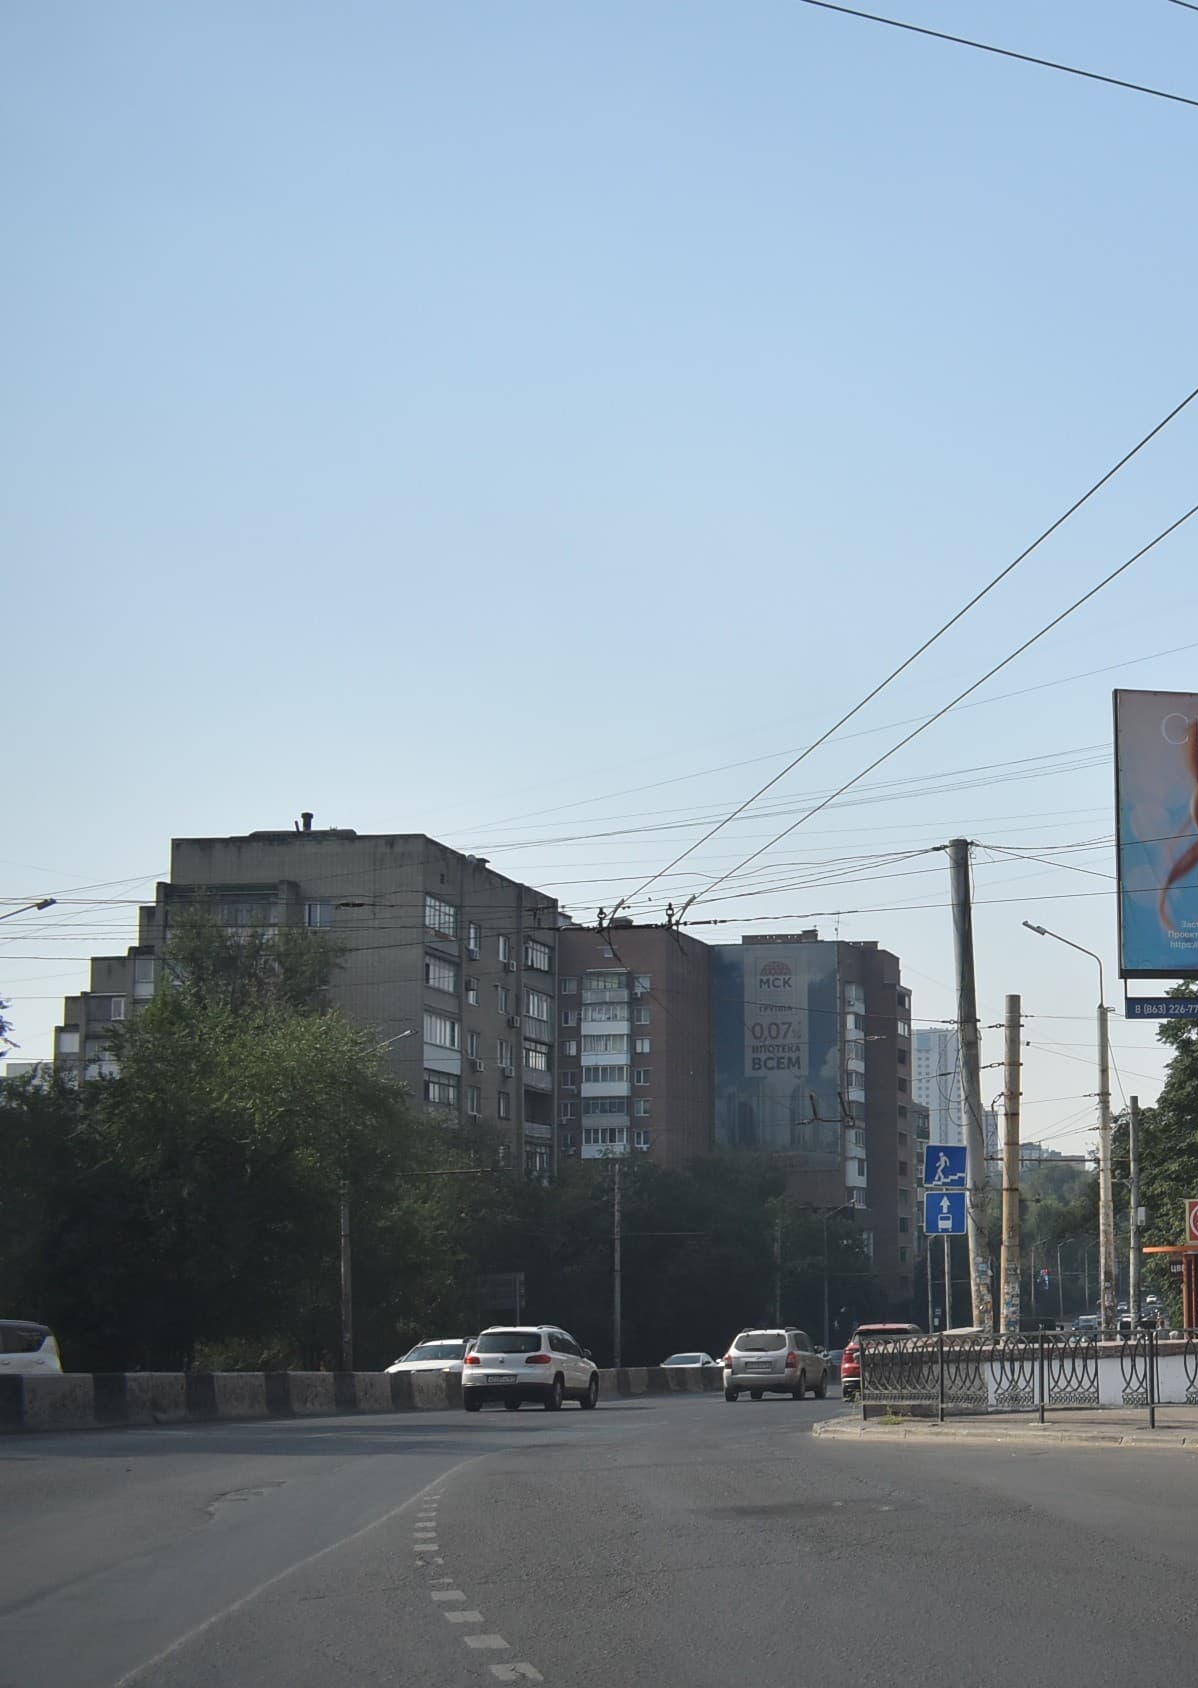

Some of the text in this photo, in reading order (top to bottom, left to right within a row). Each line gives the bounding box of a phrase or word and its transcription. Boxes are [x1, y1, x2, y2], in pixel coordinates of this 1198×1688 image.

[759, 976, 793, 989] МСК
[1143, 1003, 1166, 1015] (863)
[751, 1044, 801, 1054] ИПОТЕКА
[751, 1055, 801, 1071] ВСЕМ
